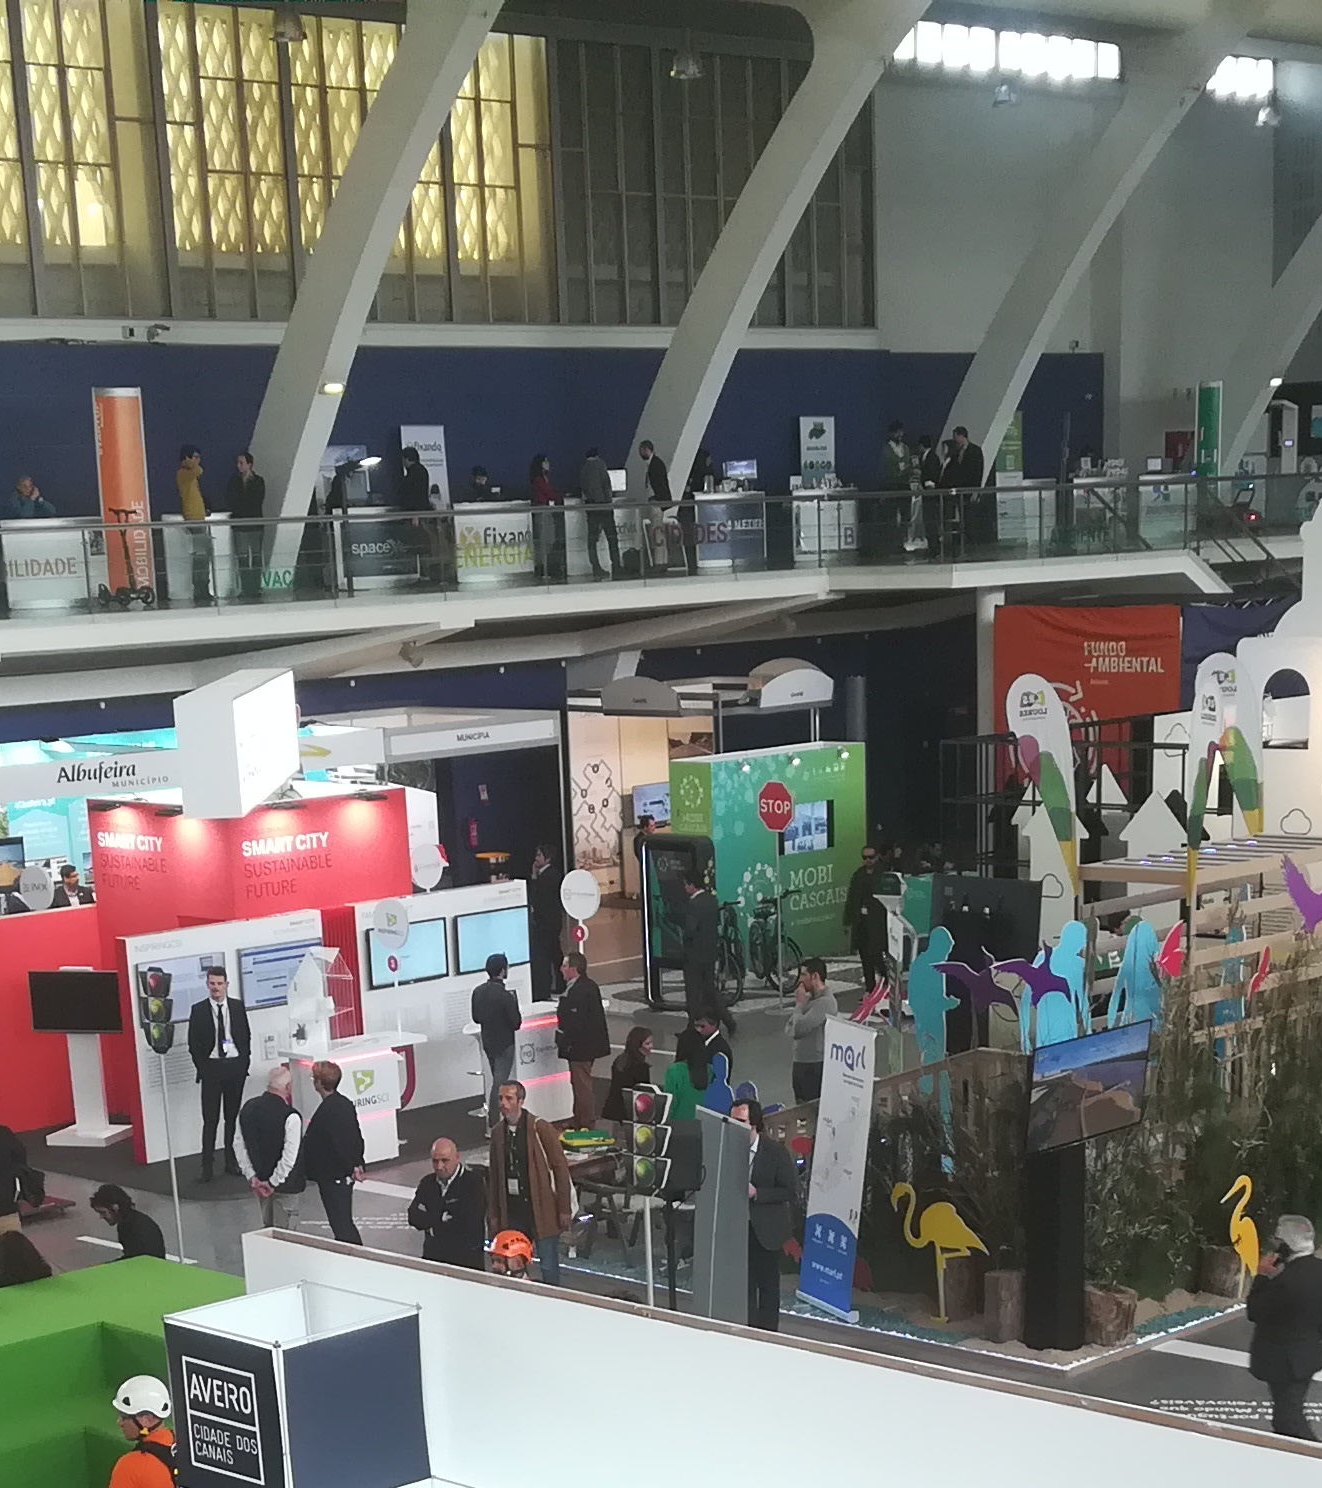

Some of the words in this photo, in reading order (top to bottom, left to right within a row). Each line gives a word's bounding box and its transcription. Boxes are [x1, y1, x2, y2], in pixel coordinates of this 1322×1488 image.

[1084, 641, 1126, 657] FUNDO
[57, 761, 137, 785] Albufeira
[112, 775, 169, 788] MUNICÍPIO
[760, 799, 791, 814] STOP
[98, 832, 135, 851] SMART
[137, 835, 163, 852] CITY
[242, 834, 294, 857] SMART
[295, 831, 330, 851] CITY
[101, 854, 168, 874] SUSTAINABLE
[244, 853, 333, 879] SUSTAINABLE
[102, 873, 142, 891] FUTURE
[245, 878, 298, 899] FUTURE
[789, 863, 835, 891] MOBI
[790, 886, 849, 911] CASCAIS
[190, 1373, 253, 1415] AVEIRO
[193, 1423, 232, 1448] CIDADE
[235, 1434, 258, 1455] DOS
[195, 1441, 234, 1465] CANAIS
